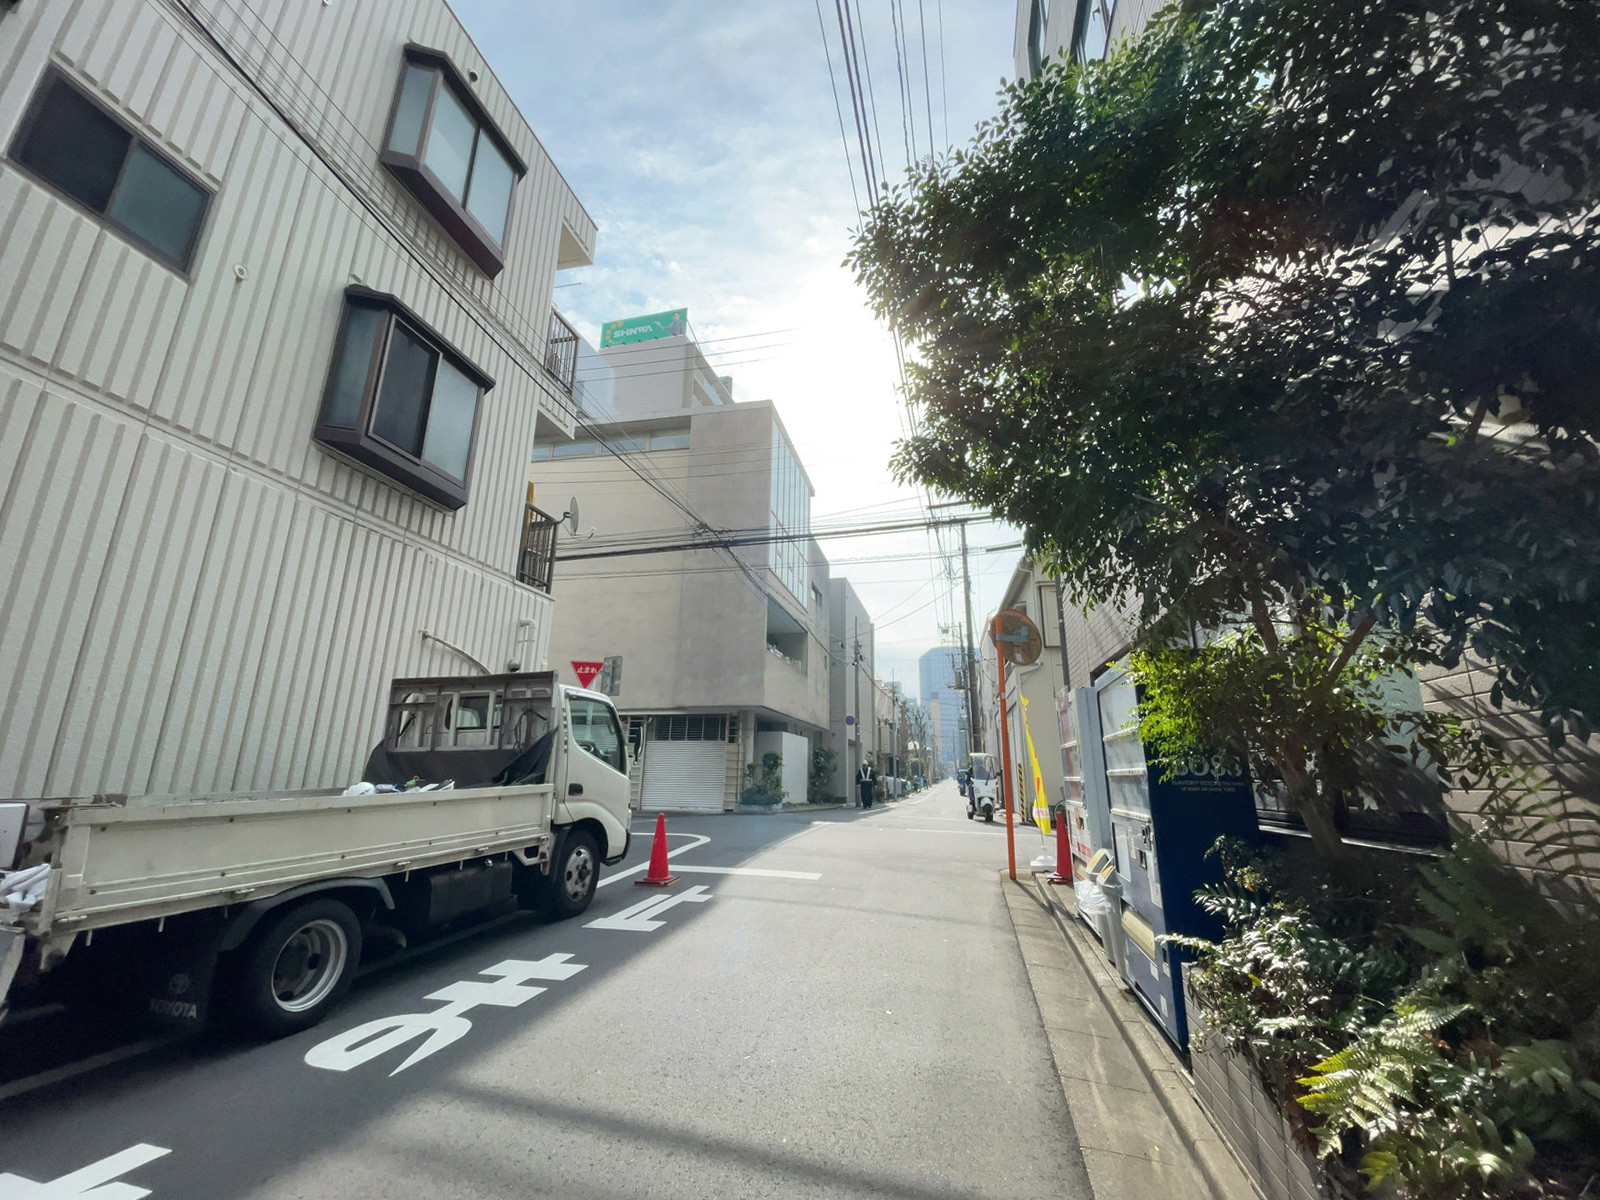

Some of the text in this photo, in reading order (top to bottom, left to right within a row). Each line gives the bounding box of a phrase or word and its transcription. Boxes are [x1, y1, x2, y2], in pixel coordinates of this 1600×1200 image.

[614, 325, 653, 338] SHINWA
[576, 666, 597, 674] 止まれ
